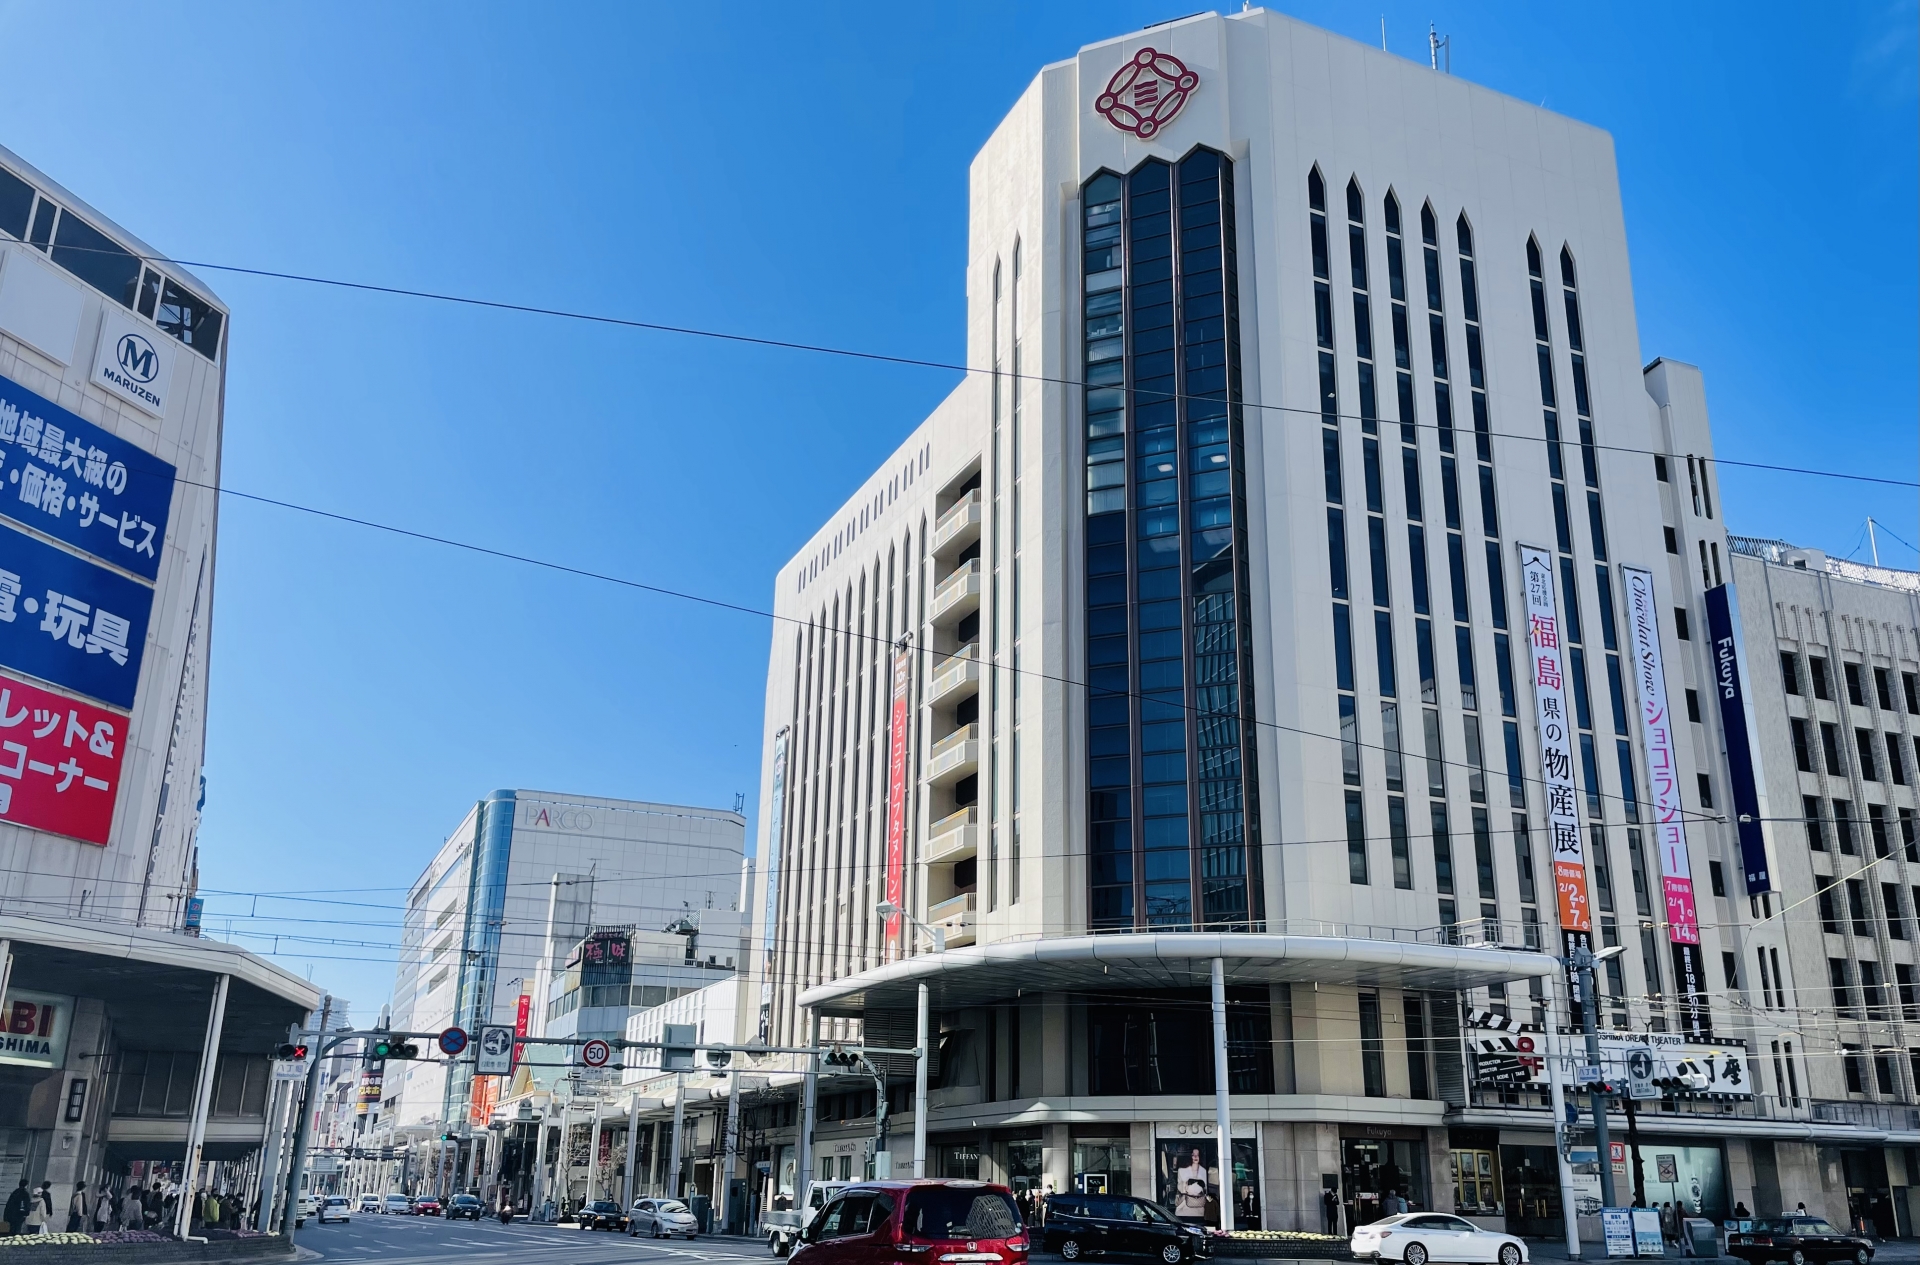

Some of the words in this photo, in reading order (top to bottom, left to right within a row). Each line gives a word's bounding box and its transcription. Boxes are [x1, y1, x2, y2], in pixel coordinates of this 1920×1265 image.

[121, 337, 154, 379] M
[104, 367, 161, 408] MARUZEN
[0, 398, 127, 496] 地域最大級の
[1530, 571, 1541, 606] 第27回
[0, 567, 131, 667] 電・玩具
[1632, 575, 1652, 648] Chocolat
[1641, 648, 1656, 696] Show
[1717, 636, 1735, 699] Fukuya
[1529, 613, 1580, 856] 福島県の物産展
[1645, 700, 1680, 874] ショコラショー
[526, 806, 595, 831] PARCO
[1673, 922, 1691, 941] 14
[0, 1001, 53, 1038] BI
[589, 1048, 603, 1059] 50
[1651, 1035, 1682, 1045] THEATER
[1178, 1124, 1233, 1135] GUCI
[1366, 1126, 1392, 1138] Fukuya
[954, 1152, 980, 1160] TIFFAN
